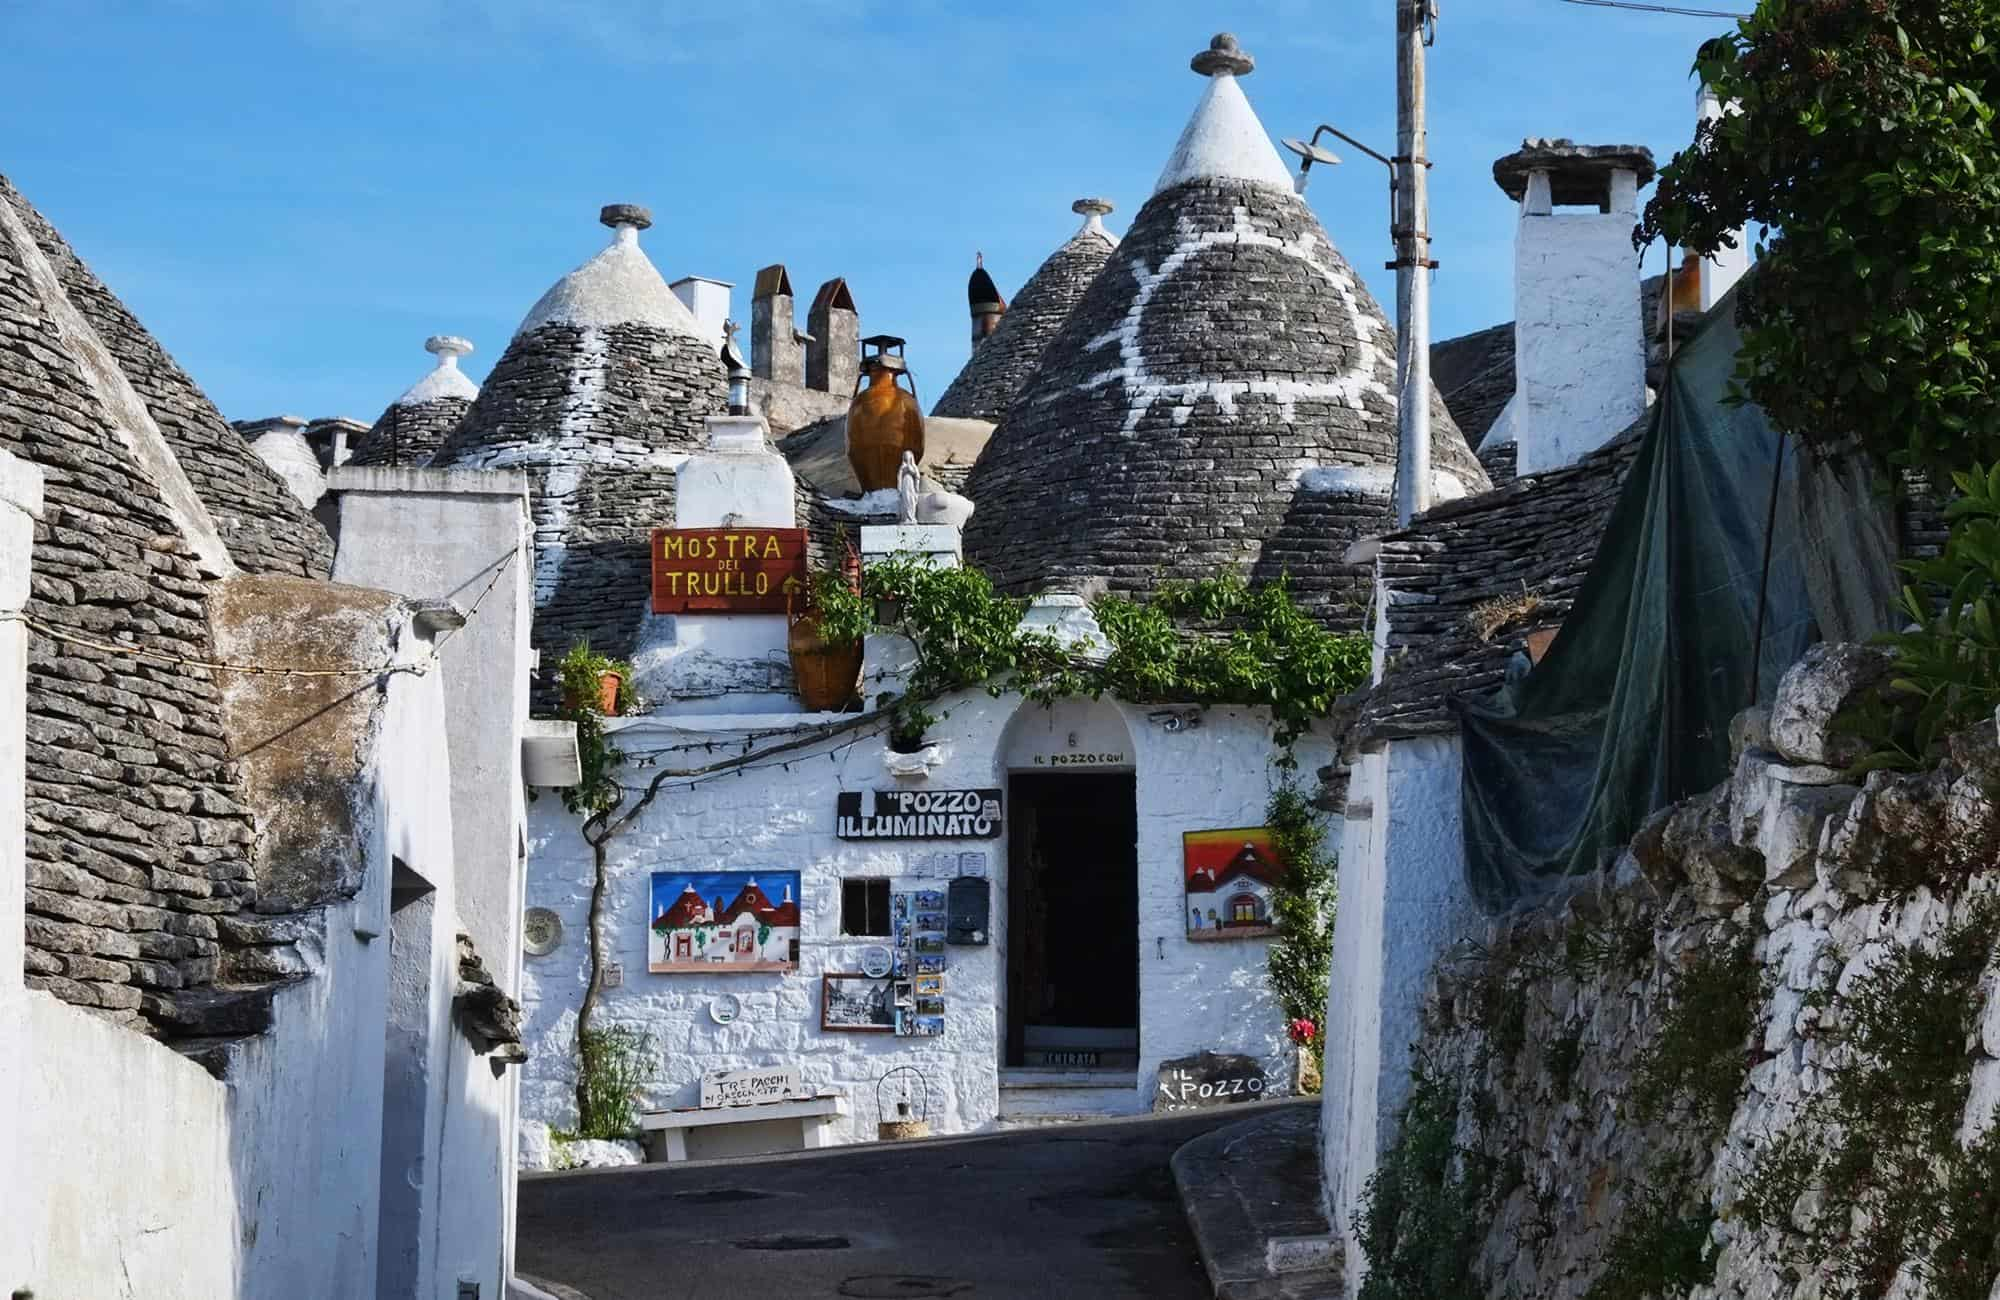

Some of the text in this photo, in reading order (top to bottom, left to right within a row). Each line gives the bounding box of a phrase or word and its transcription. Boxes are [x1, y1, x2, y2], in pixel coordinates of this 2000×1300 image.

[664, 535, 782, 559] MOSTRA
[718, 560, 740, 571] DEL
[665, 572, 768, 596] TRULLO
[1034, 755, 1045, 764] IL
[1051, 753, 1097, 766] POZZO
[838, 814, 992, 837] ILLUMINATO
[1172, 1068, 1193, 1080] IL
[713, 1075, 789, 1094] TRE PACCHI
[1180, 1078, 1263, 1100] POZZO
